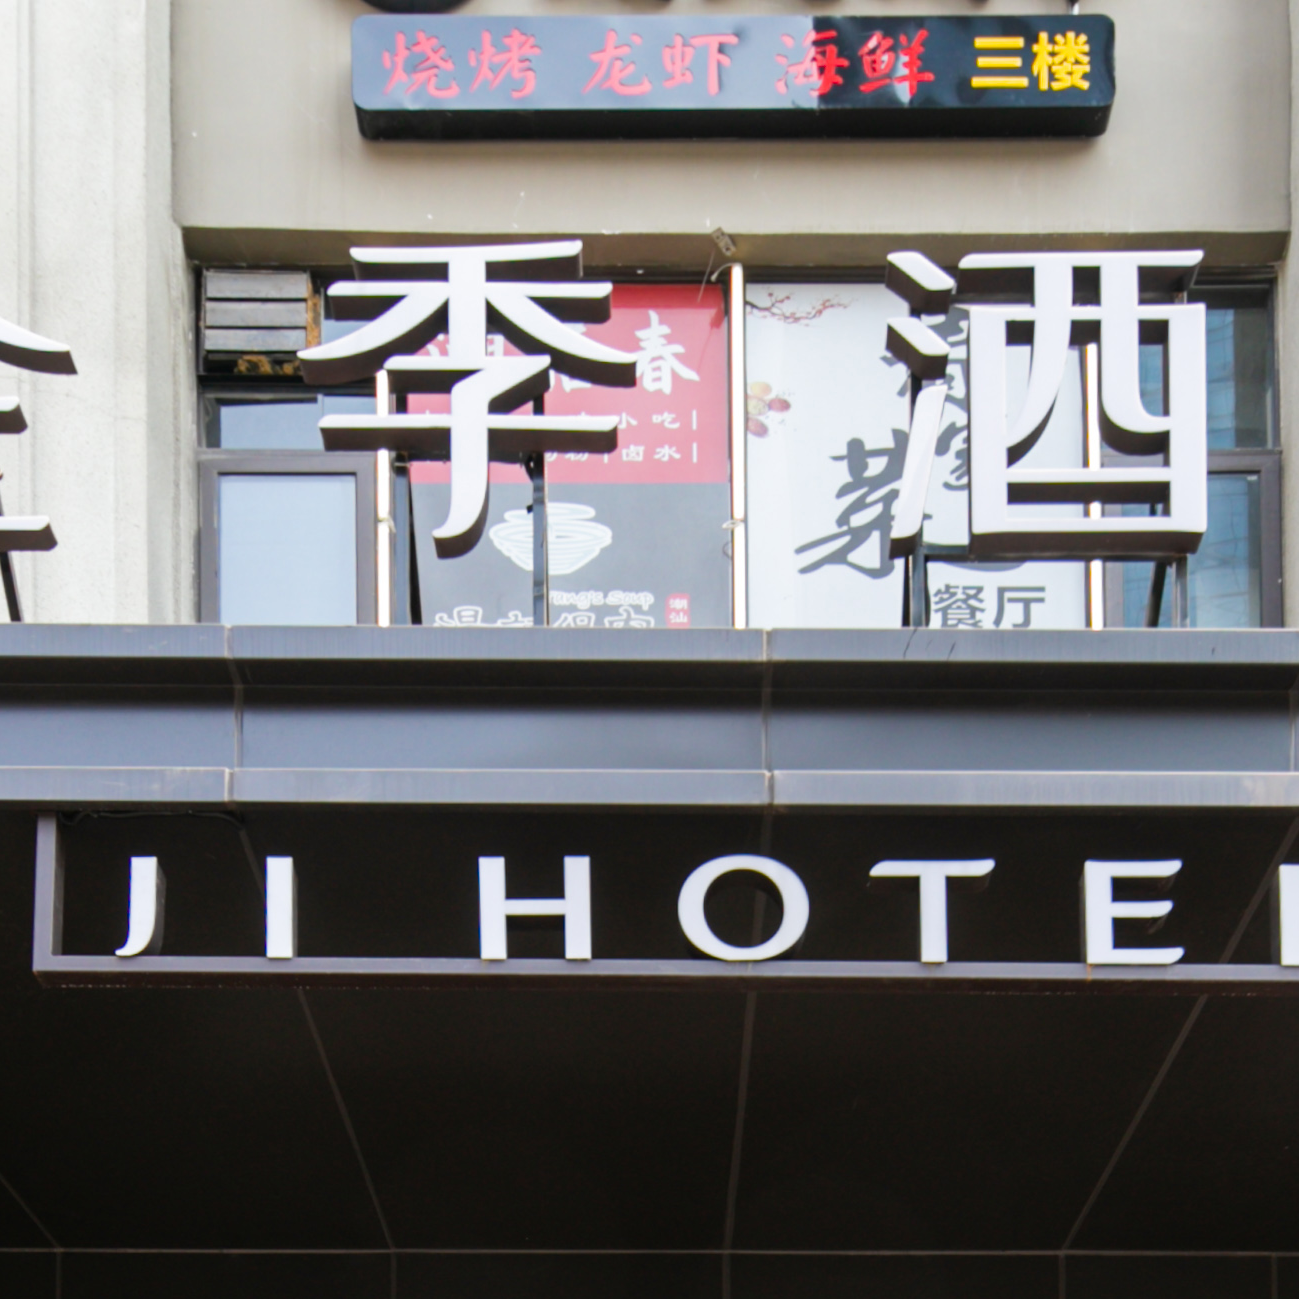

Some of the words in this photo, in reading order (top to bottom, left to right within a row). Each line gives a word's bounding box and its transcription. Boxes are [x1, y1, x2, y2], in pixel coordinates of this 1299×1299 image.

[382, 29, 543, 99] 烧烤
[585, 27, 739, 97] 龙虾
[774, 27, 935, 98] 海鲜
[970, 31, 1092, 92] 三楼
[605, 590, 654, 610] Soup
[932, 583, 1046, 629] 餐厅
[114, 855, 294, 959] JI
